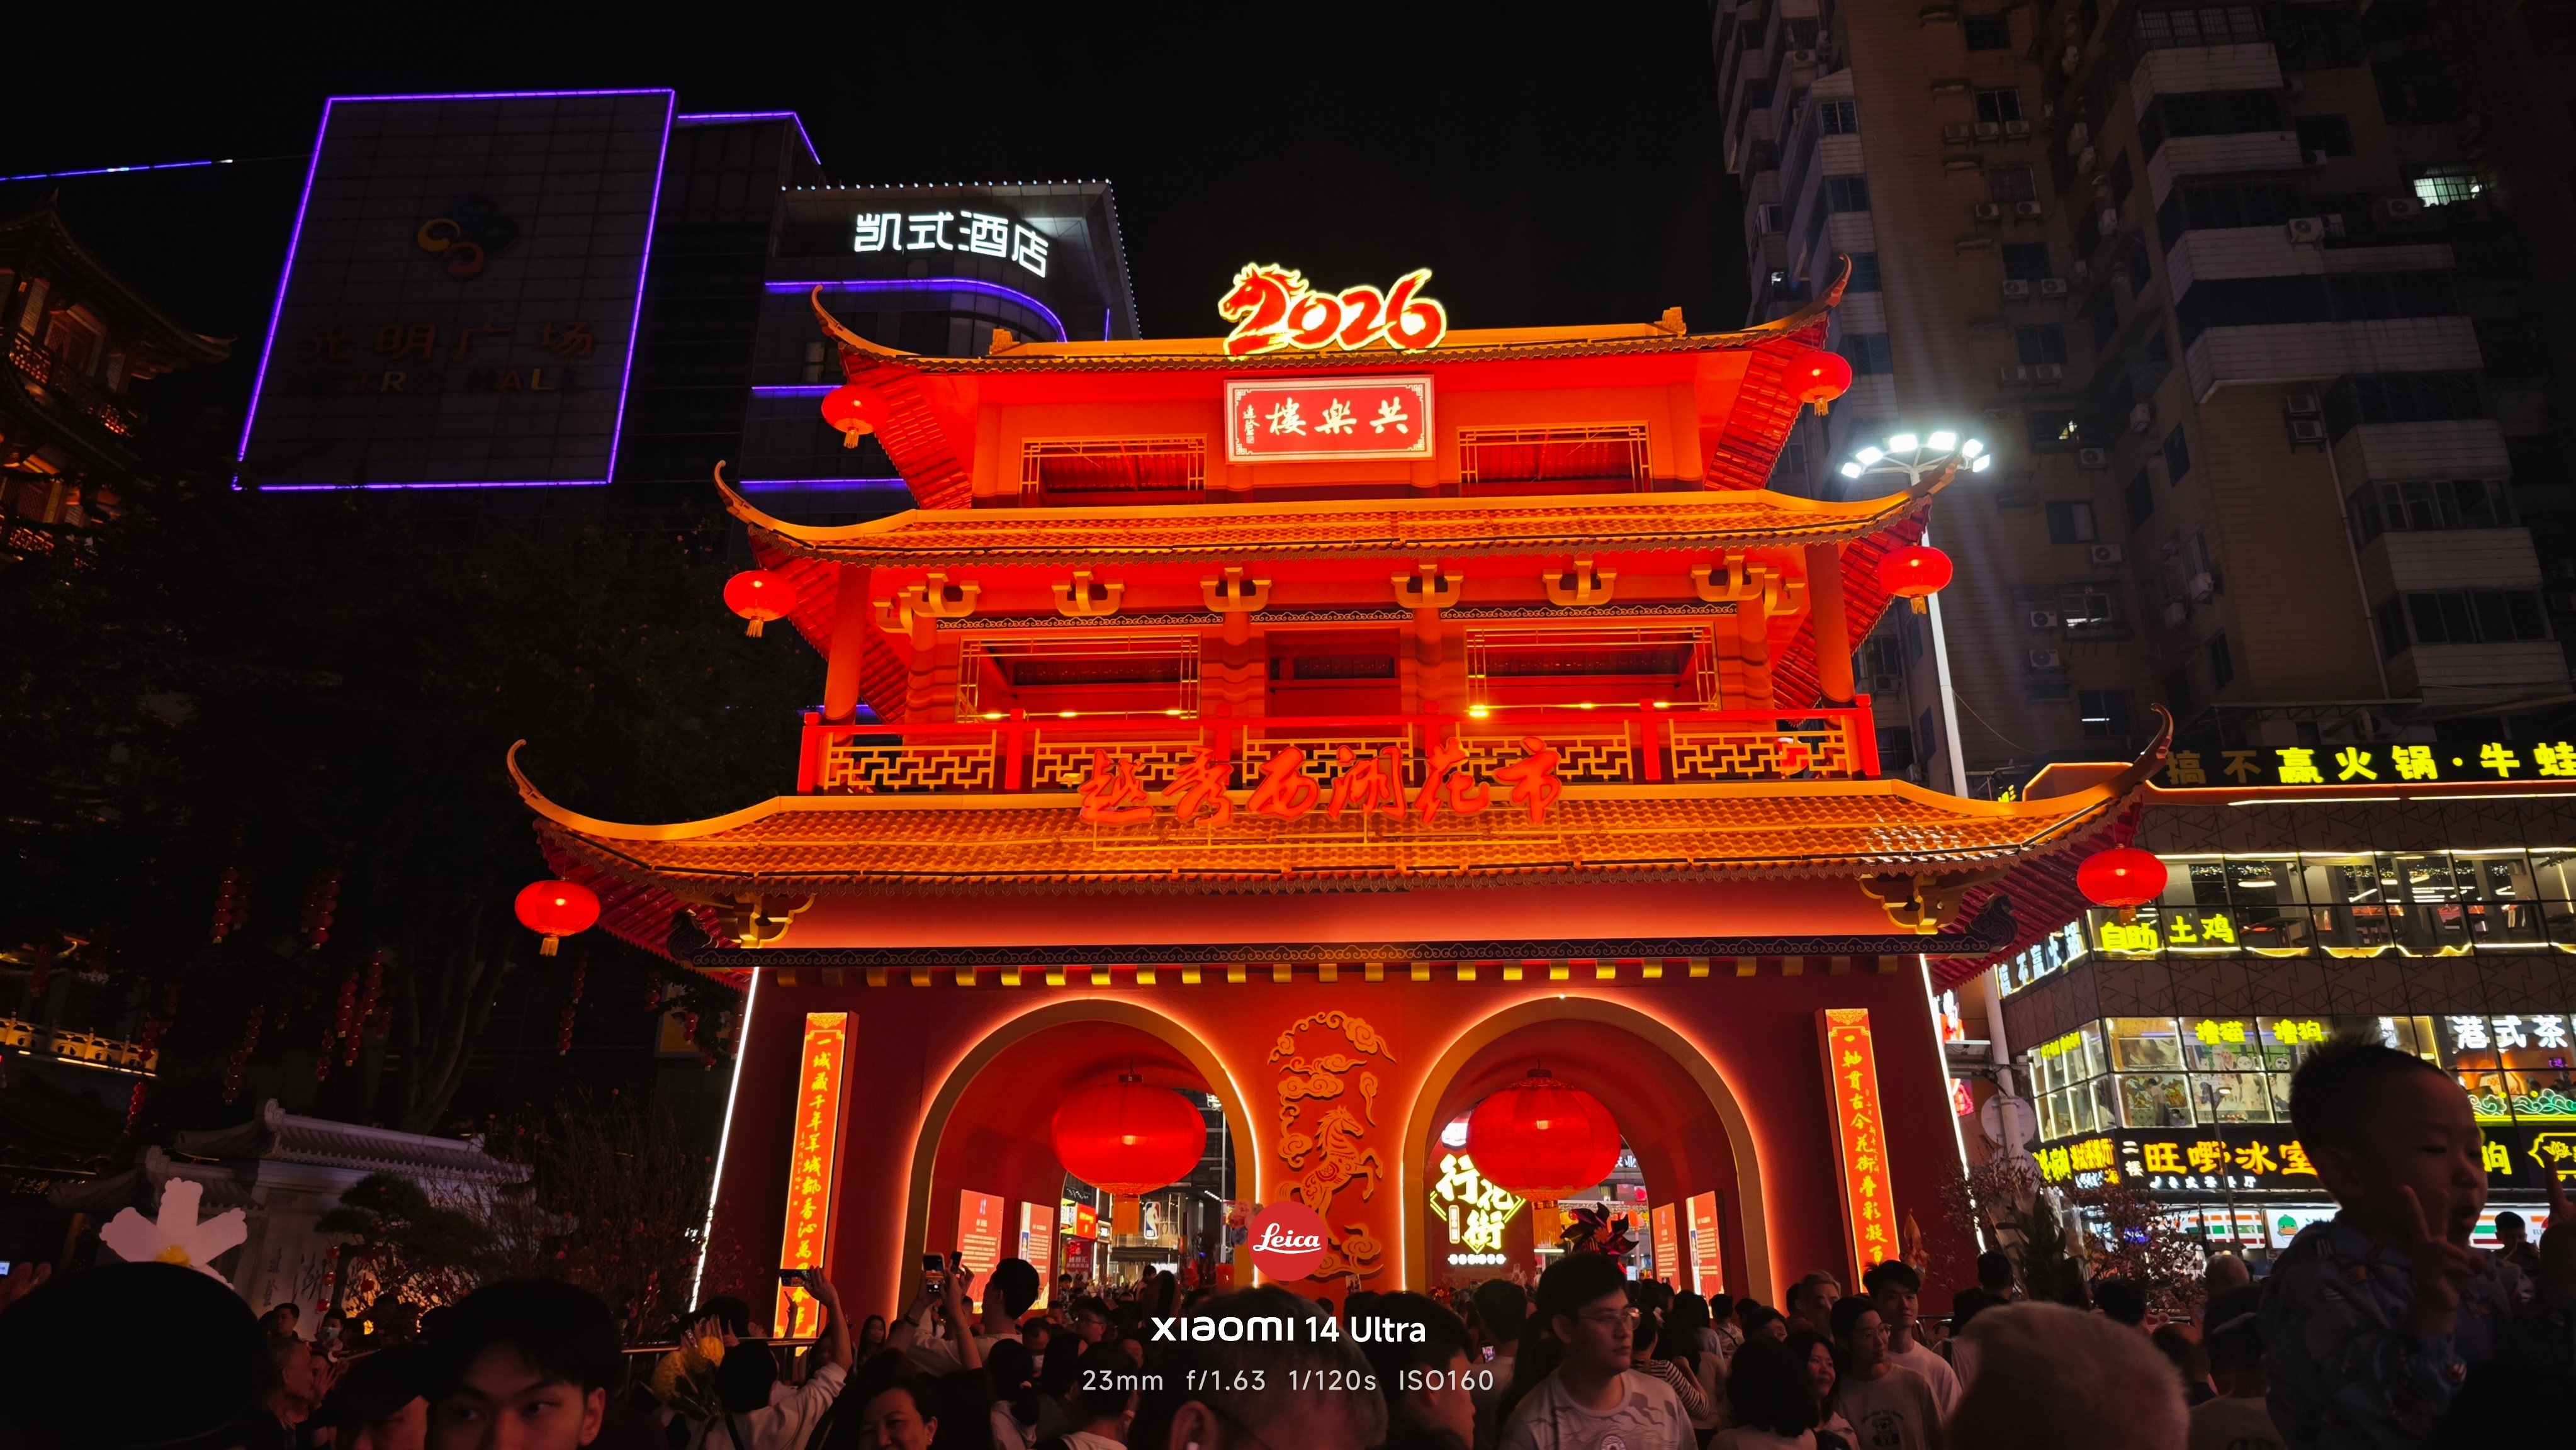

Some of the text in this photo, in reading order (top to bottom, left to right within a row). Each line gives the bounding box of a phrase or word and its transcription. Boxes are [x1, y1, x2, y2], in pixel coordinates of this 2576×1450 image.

[854, 210, 1049, 278] 凯式酒店
[1218, 263, 1446, 359] 2026
[299, 322, 595, 361] 光明广场
[1264, 396, 1409, 436] 共樂樓
[1078, 738, 1563, 826] 越秀西湖花市
[2165, 741, 2576, 784] 搞不赢火锅·牛蛙
[2100, 913, 2236, 952] 自助 土鸡
[2453, 1014, 2576, 1050] 港式茶
[2143, 1139, 2319, 1176] 旺嘢冰室
